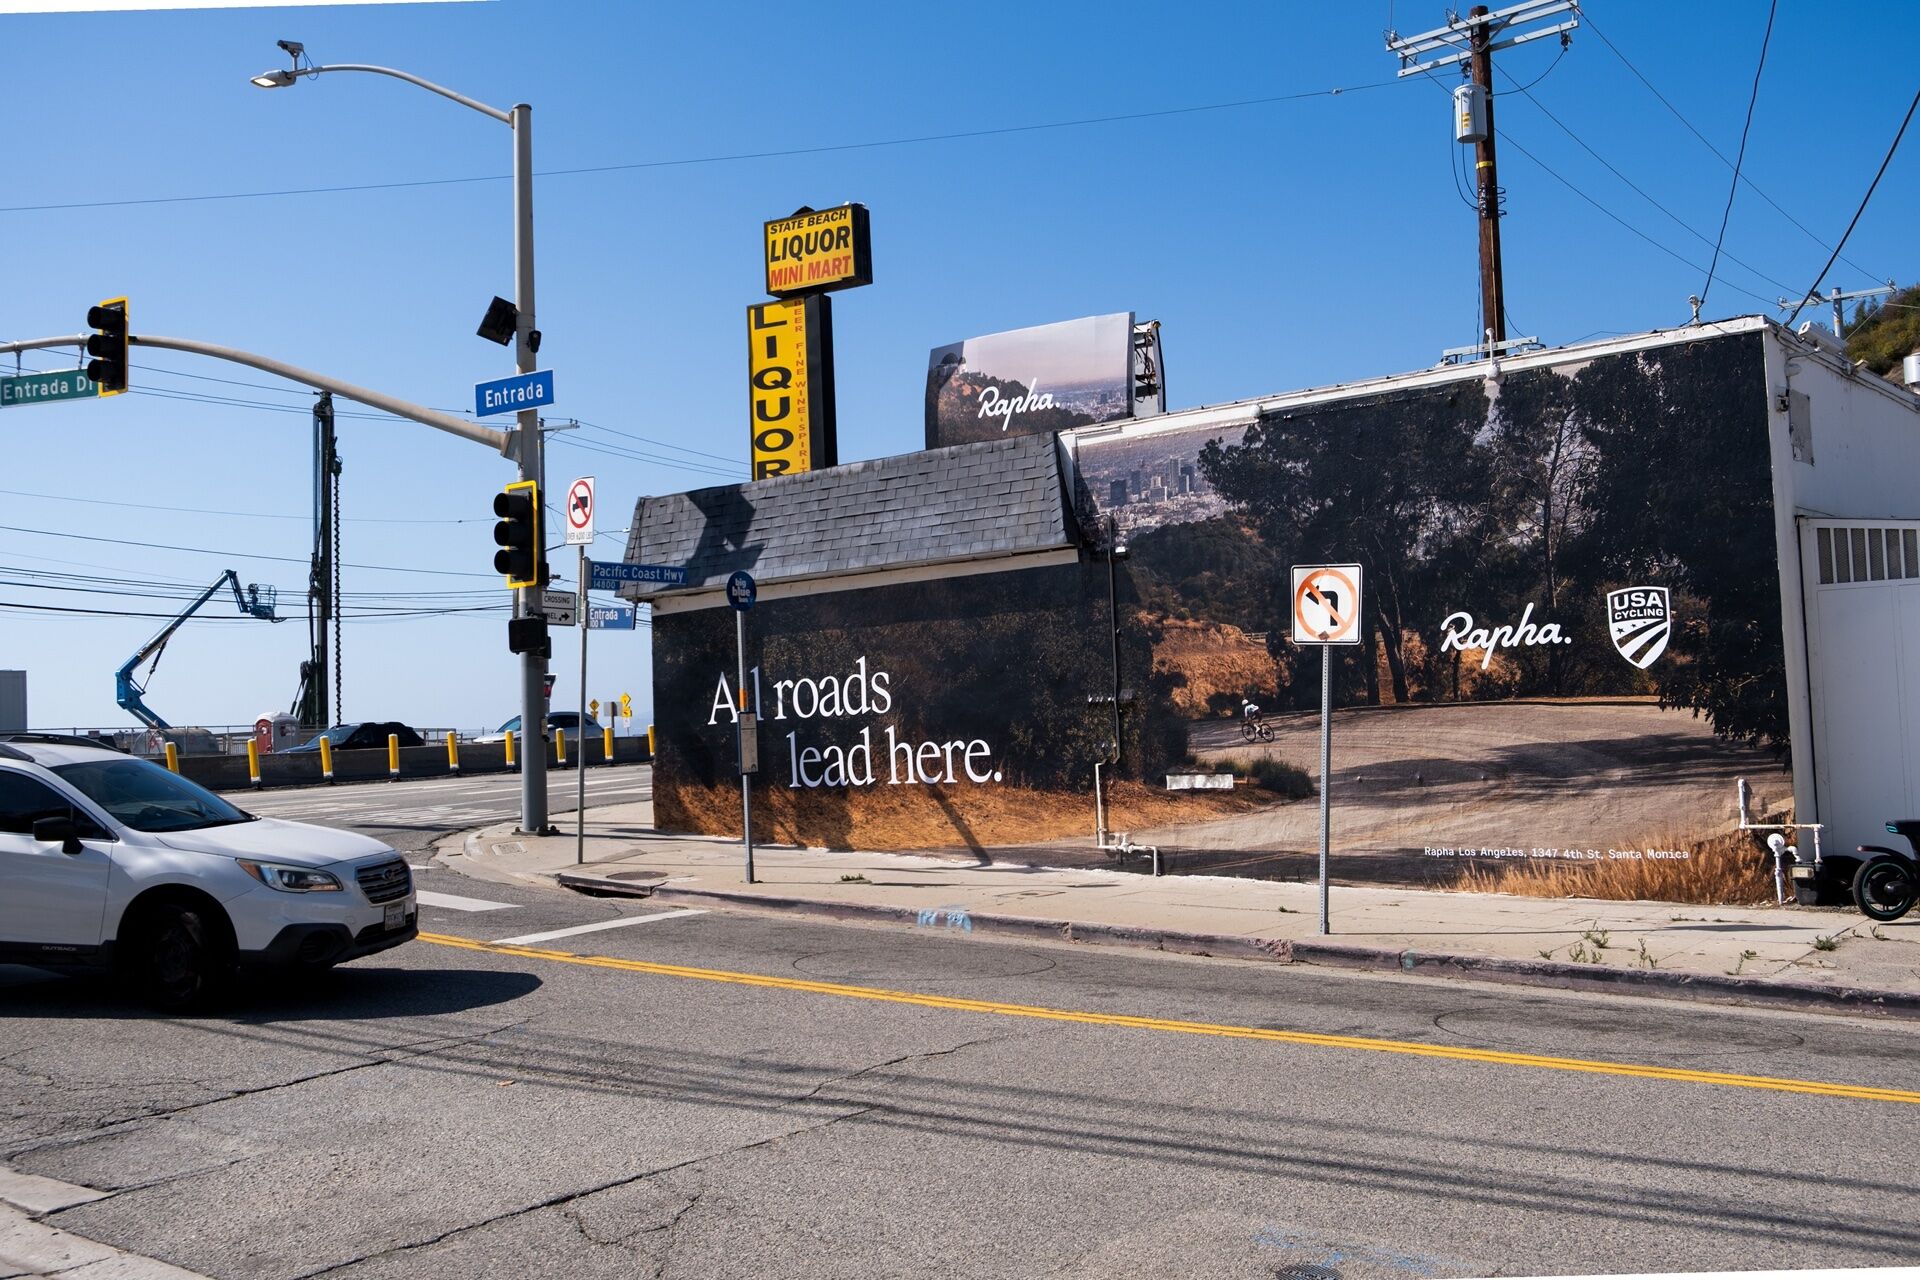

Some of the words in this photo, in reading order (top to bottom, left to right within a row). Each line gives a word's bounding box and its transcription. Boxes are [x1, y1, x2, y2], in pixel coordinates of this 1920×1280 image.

[770, 218, 804, 235] STATE
[807, 209, 848, 227] BEACH
[770, 225, 851, 263] LIQUOR
[770, 264, 803, 288] MINI
[807, 255, 851, 281] MART
[796, 342, 804, 375] FINE
[3, 379, 69, 400] Entrada
[485, 381, 543, 408] Entrada
[753, 306, 794, 482] LIQUOR
[795, 380, 806, 414] WINE
[978, 377, 1060, 431] Rapha.
[593, 564, 627, 579] Pacific
[631, 567, 661, 580] Coast
[663, 569, 684, 583] Hwy
[593, 580, 616, 589] 14800
[543, 595, 570, 604] CROSSING
[732, 585, 751, 597] blue
[1613, 592, 1664, 610] USA
[589, 608, 618, 620] Entrada
[625, 608, 632, 617] Dr
[1614, 608, 1664, 620] CYCLING
[1440, 602, 1572, 670] Rapha.
[708, 665, 764, 725] Al
[773, 655, 892, 720] roads
[786, 726, 876, 788] lead
[884, 725, 1003, 786] here.
[1424, 846, 1455, 858] Rapha
[1458, 846, 1476, 857] Los
[1480, 847, 1527, 858] Angeles,
[1531, 848, 1558, 858] 1347
[1563, 849, 1583, 859] 4th
[1608, 849, 1642, 859] Santa
[1647, 848, 1689, 859] Monica
